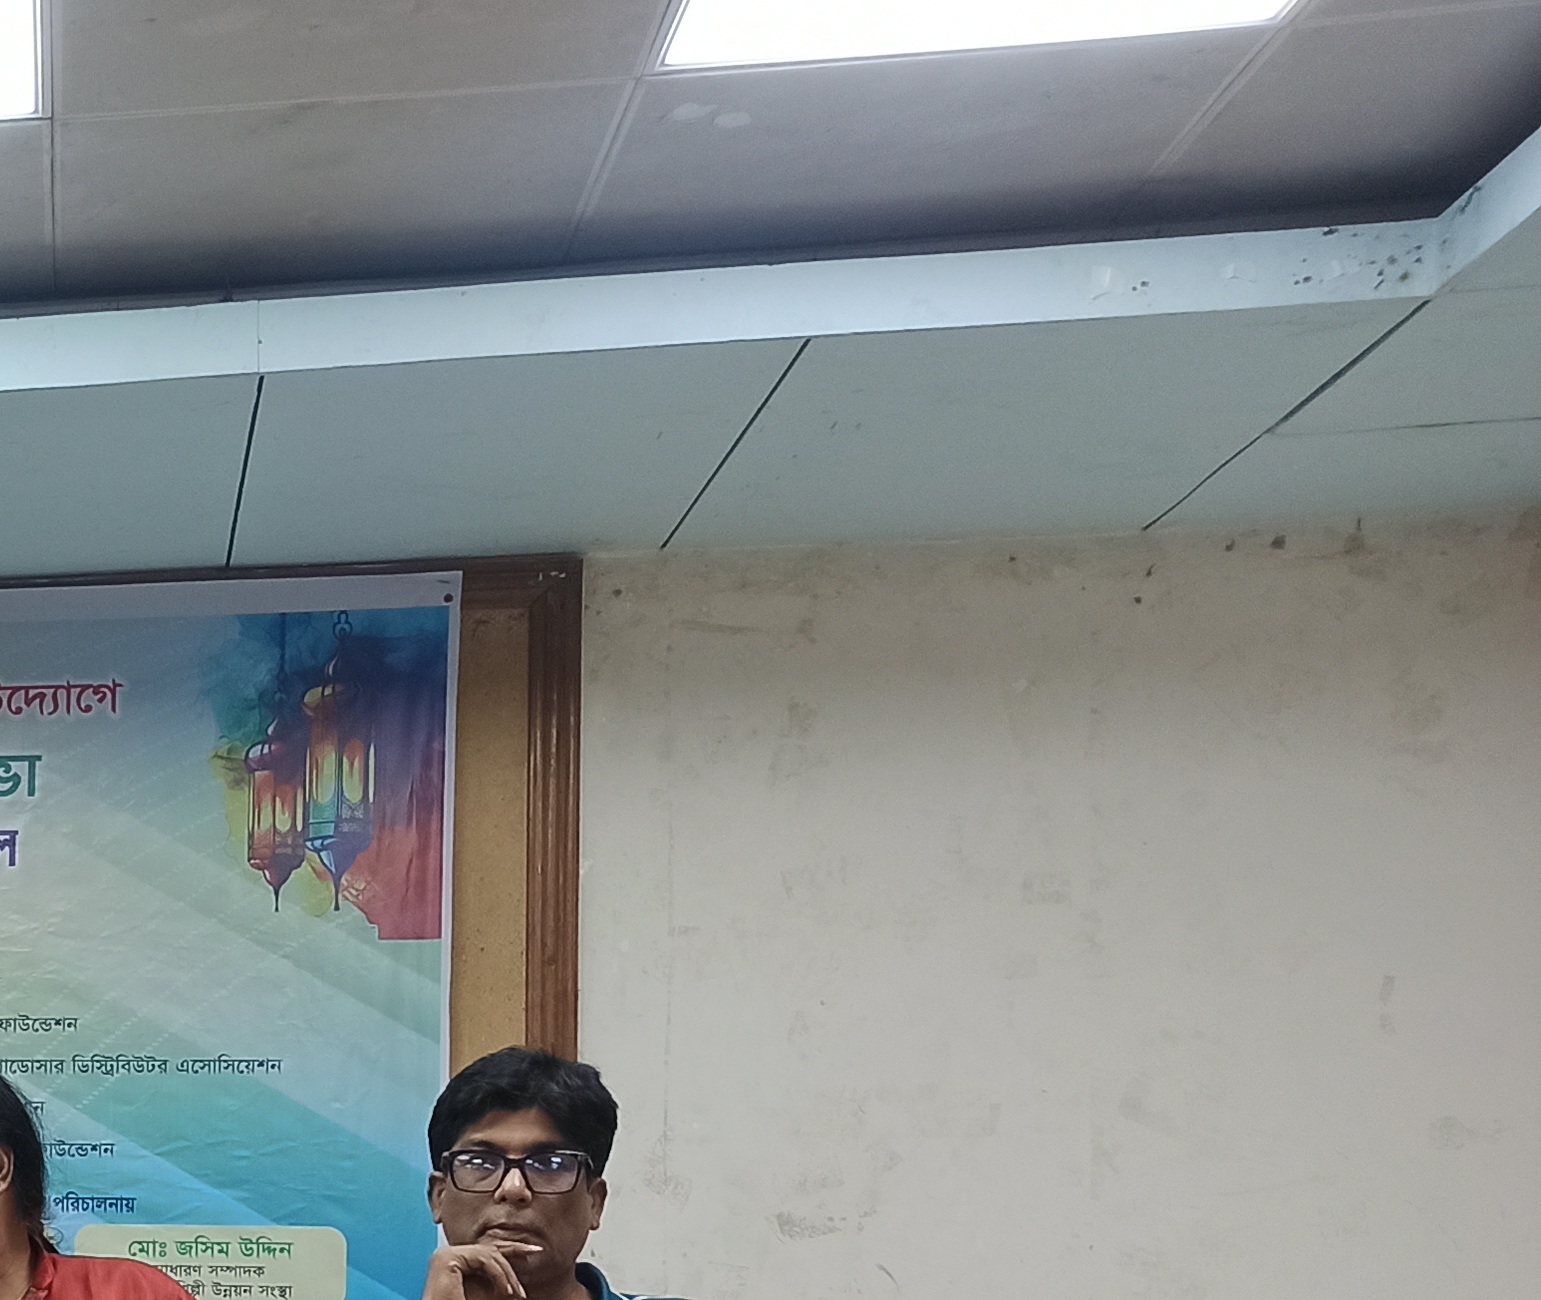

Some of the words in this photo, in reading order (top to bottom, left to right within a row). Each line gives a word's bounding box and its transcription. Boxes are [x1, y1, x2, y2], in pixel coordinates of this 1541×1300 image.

[176, 1054, 283, 1076] এসোসিয়েশন
[52, 1190, 138, 1214] পরিচালনায়
[128, 1238, 168, 1259] মোঃ
[175, 1234, 232, 1259] জসিম
[239, 1236, 294, 1260] উদ্দিন
[208, 1264, 266, 1278] সম্পাদক
[211, 1280, 253, 1299] উন্নয়ন
[258, 1284, 294, 1300] সংস্থা
